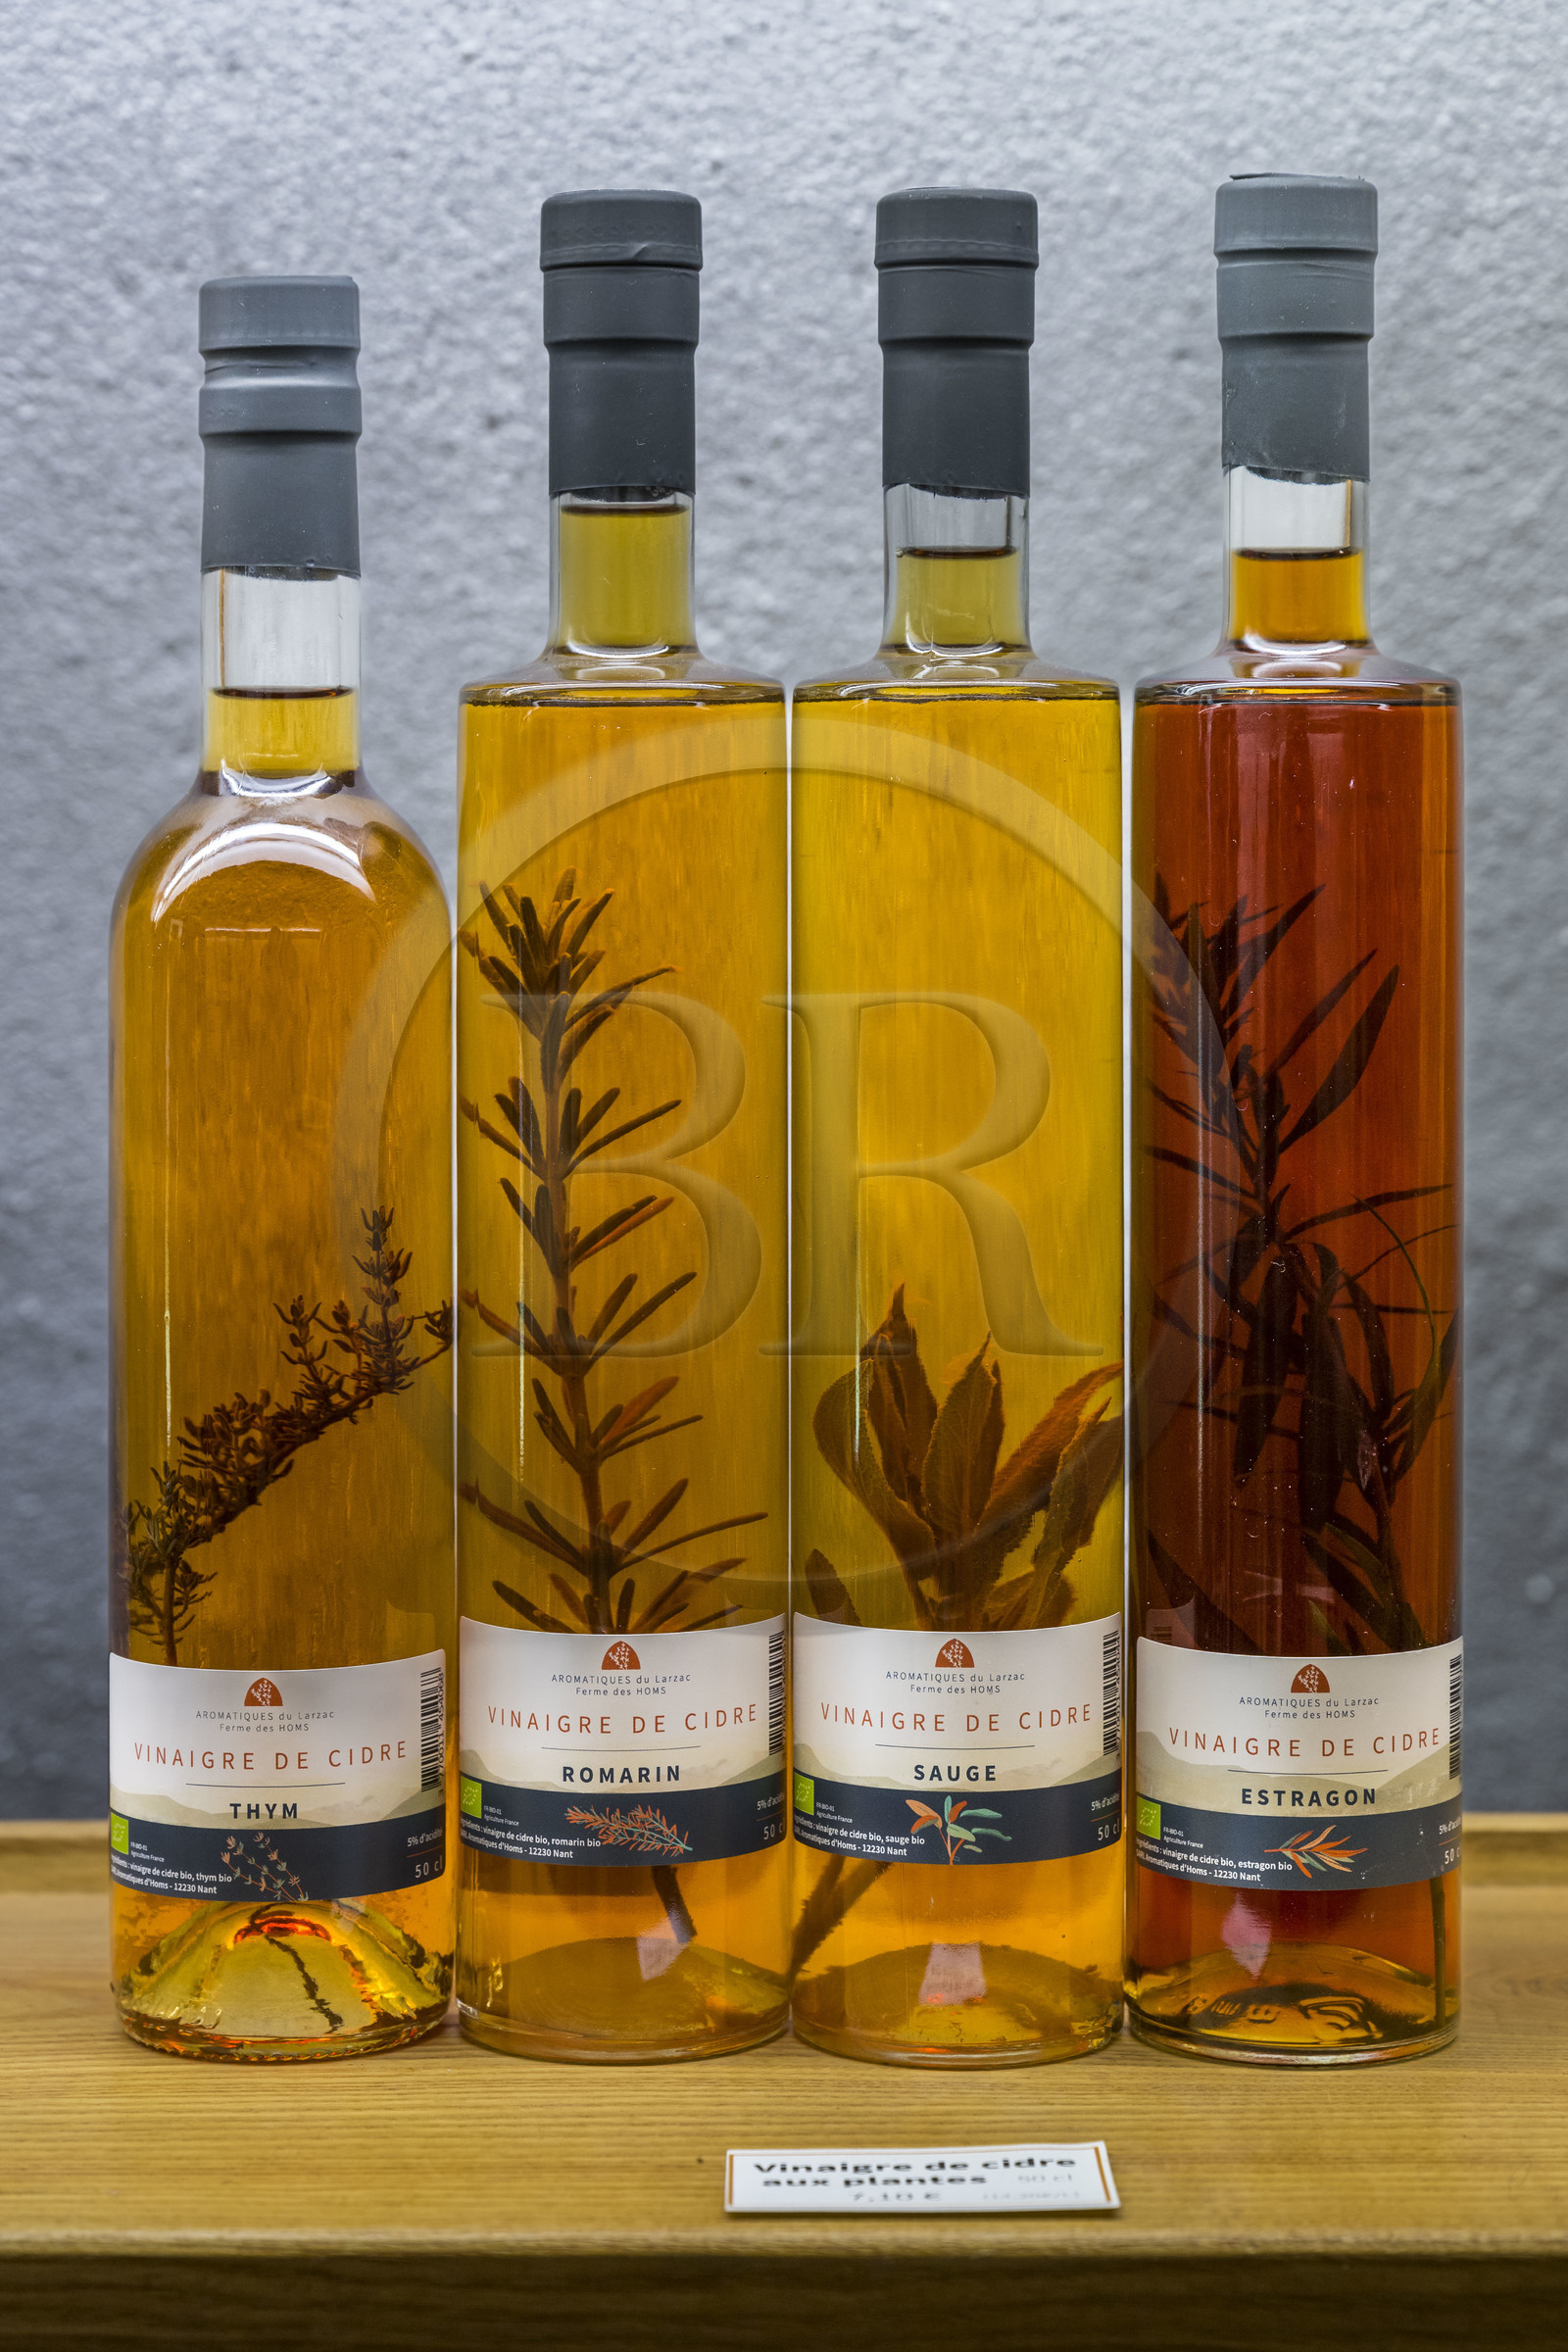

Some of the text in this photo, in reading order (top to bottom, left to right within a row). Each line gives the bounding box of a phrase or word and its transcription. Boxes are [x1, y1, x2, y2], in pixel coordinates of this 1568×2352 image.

[552, 1675, 630, 1686] AROMATIQUES
[886, 1671, 964, 1683] AROMATIQUES
[910, 1685, 942, 1693] Ferme
[1240, 1696, 1379, 1708] AROMATIQUES du Larzac
[196, 1711, 273, 1722] AROMATIQUES
[488, 1703, 757, 1734] VINAIGRE DE CIDRE
[821, 1702, 1091, 1732] VINAIGRE DE CIDRE
[278, 1723, 309, 1732] HOMS
[1169, 1727, 1440, 1757] VINAIGRE DE CIDRE
[134, 1740, 407, 1770] VINAIGRE DE CIDRE
[563, 1765, 680, 1784] ROMARIN
[913, 1764, 997, 1782] SAUGE
[1092, 1800, 1101, 1810] 5%
[1242, 1788, 1376, 1807] ESTRAGON
[229, 1803, 299, 1820] THYM
[816, 1811, 837, 1821] Agriculture
[483, 1826, 506, 1838] vinaigre
[507, 1831, 514, 1839] de
[515, 1833, 533, 1842] cidre
[535, 1835, 550, 1845] bio,
[763, 1824, 775, 1839] 50
[816, 1823, 839, 1836] vinaigre
[840, 1828, 848, 1837] de
[850, 1829, 867, 1839] cidre
[868, 1831, 884, 1842] bio,
[885, 1836, 909, 1845] sauge
[911, 1836, 925, 1844] bio
[1098, 1825, 1109, 1840] 50
[408, 1837, 418, 1846] 5%
[831, 1838, 857, 1850] d'Homs
[862, 1844, 885, 1854] 12230
[887, 1846, 906, 1856] Nant
[1163, 1836, 1186, 1846] Agriculture
[498, 1841, 522, 1853] d'Homs
[529, 1847, 552, 1857] 12230
[553, 1849, 573, 1858] Nant
[1445, 1848, 1454, 1864] 50
[416, 1855, 442, 1878] 50 cl
[1162, 1848, 1188, 1861] vinaigre
[1190, 1852, 1199, 1862] de
[1200, 1854, 1219, 1865] cidre
[1221, 1857, 1237, 1869] bio,
[1239, 1860, 1276, 1872] estragon
[1278, 1861, 1292, 1871] bio
[130, 1862, 151, 1875] vinaigre
[152, 1867, 160, 1876] de
[161, 1869, 178, 1878] cidre
[180, 1871, 195, 1882] bio,
[196, 1873, 217, 1884] thym
[1180, 1863, 1207, 1876] d'Homs
[1213, 1869, 1238, 1880] 12230
[1240, 1872, 1260, 1882] Nant
[144, 1878, 169, 1889] d'Homs
[174, 1884, 196, 1892] 12230
[754, 2158, 1076, 2174] Vinaigre de cidre
[762, 2174, 987, 2188] aux plantes
